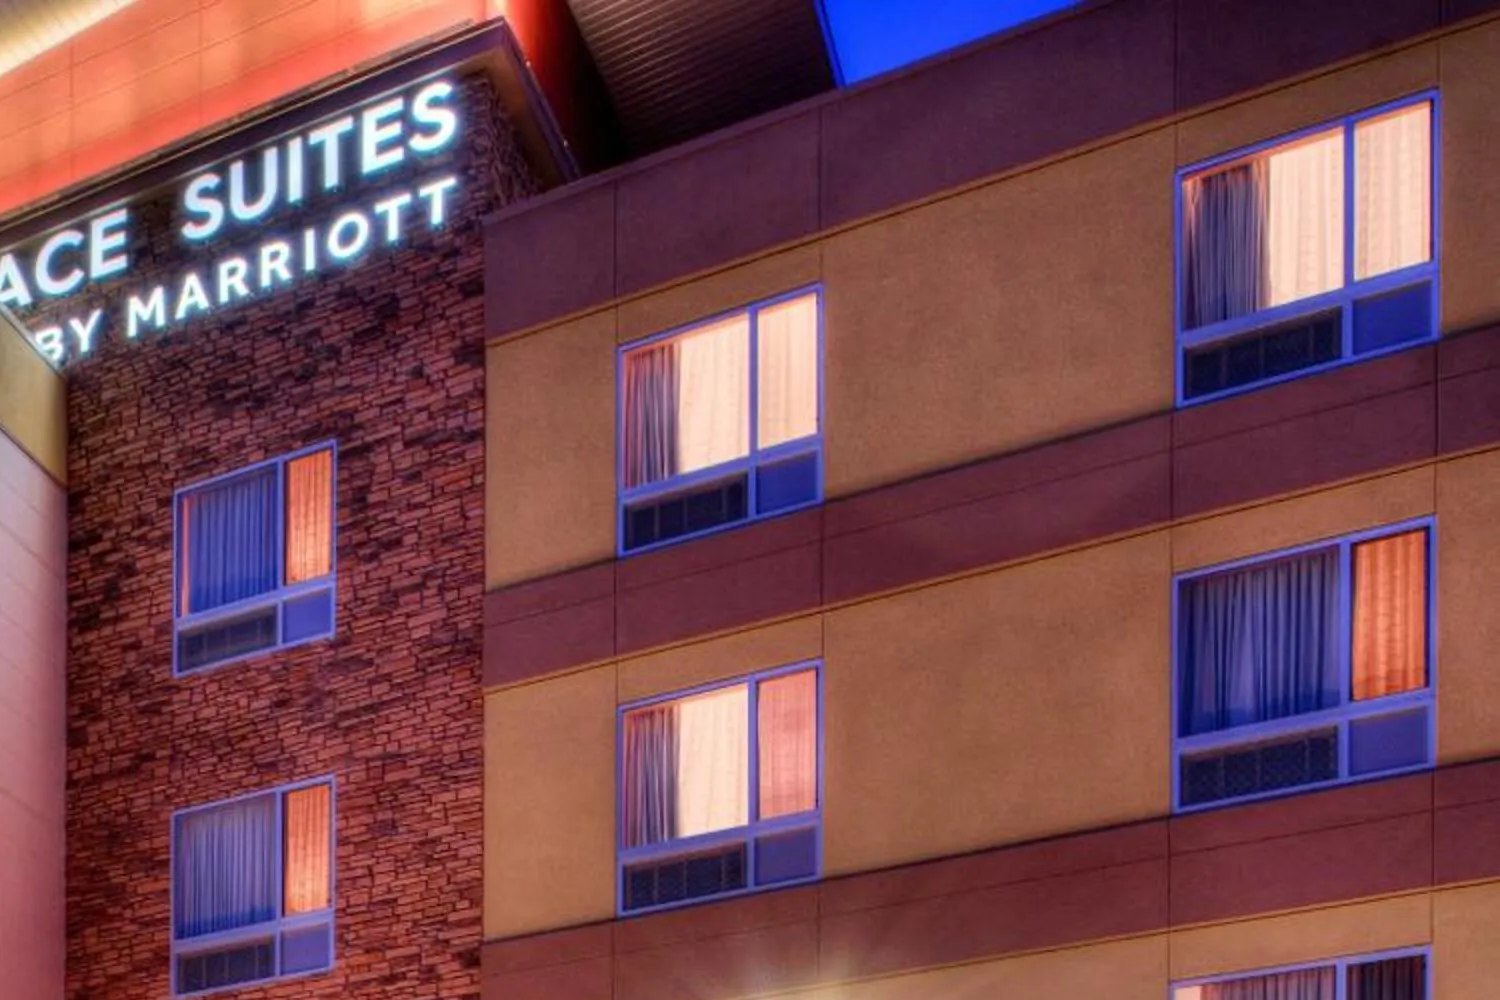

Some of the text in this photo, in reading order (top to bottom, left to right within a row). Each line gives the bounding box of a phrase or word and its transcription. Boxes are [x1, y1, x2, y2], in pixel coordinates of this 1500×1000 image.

[181, 81, 457, 240] SUITES
[35, 176, 457, 362] BY MARRIOTT
